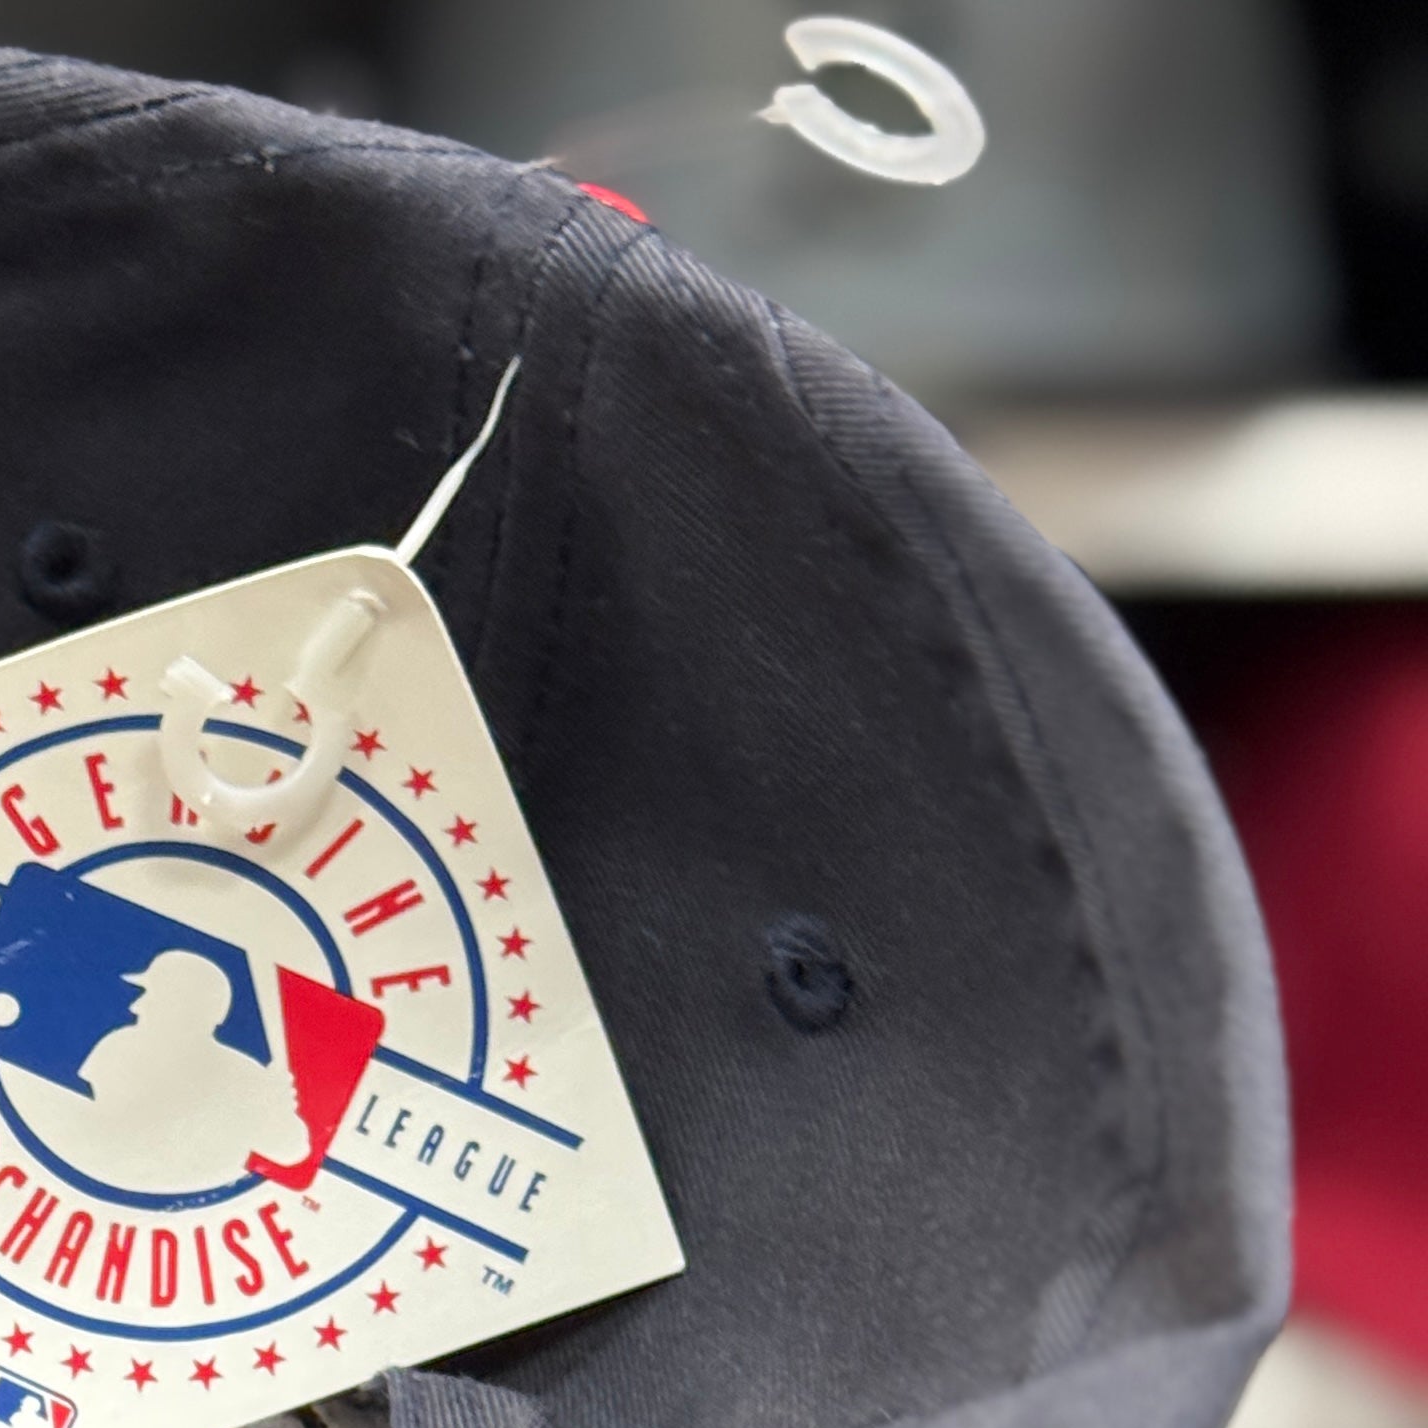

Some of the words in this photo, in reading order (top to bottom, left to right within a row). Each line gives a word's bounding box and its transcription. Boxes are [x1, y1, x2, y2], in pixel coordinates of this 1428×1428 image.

[0, 753, 451, 998] GEINE
[355, 1094, 547, 1212] LEAGUE
[481, 1264, 515, 1296] TM
